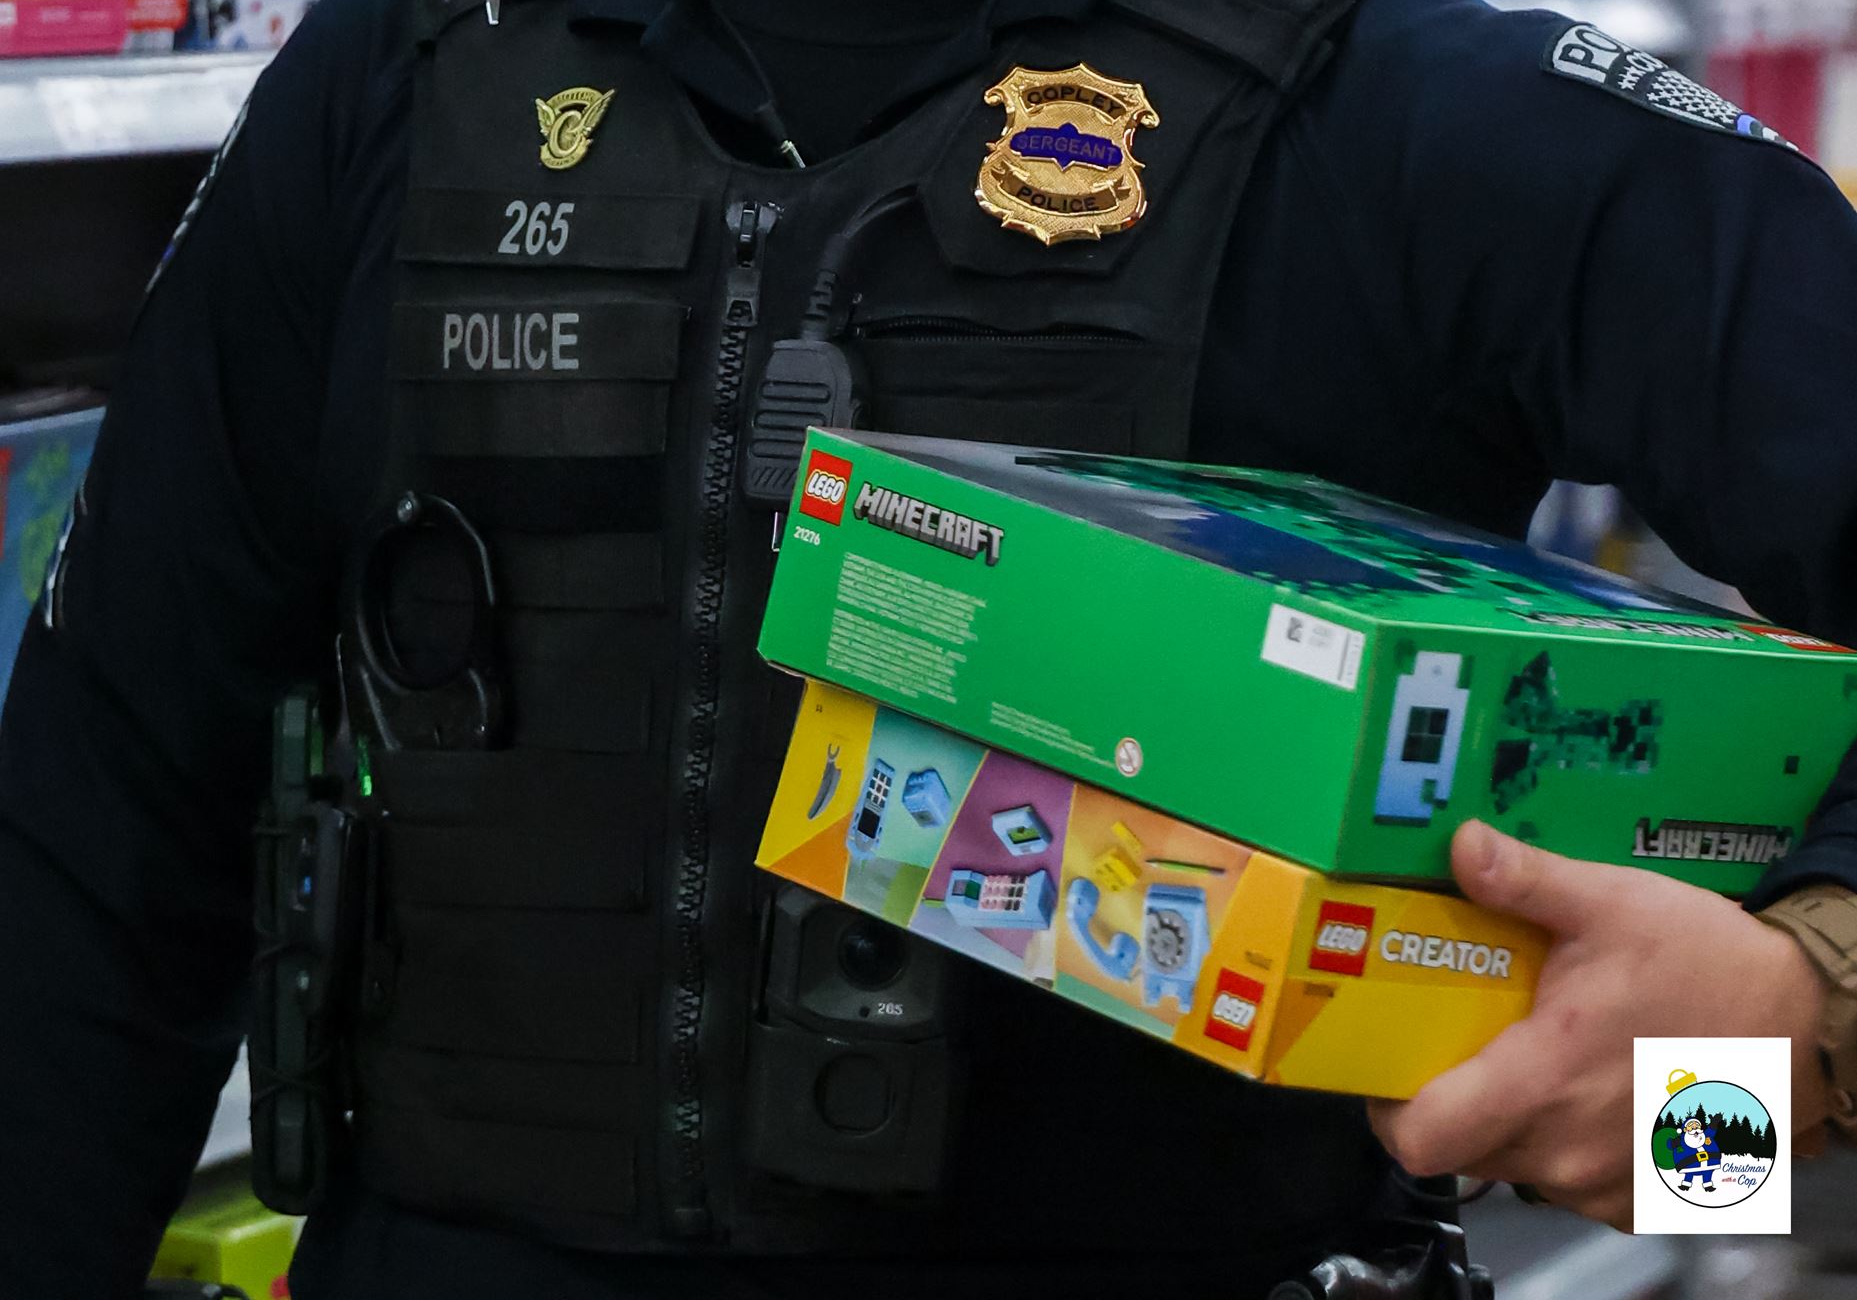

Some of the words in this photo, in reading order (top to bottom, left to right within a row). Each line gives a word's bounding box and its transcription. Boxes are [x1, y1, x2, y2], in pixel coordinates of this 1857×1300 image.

[1026, 85, 1121, 115] COPLEY
[1016, 134, 1116, 163] SERGEANT
[1016, 186, 1099, 212] POLICE
[498, 200, 575, 255] 265
[443, 312, 579, 370] POLICE
[793, 525, 821, 547] 21276
[806, 471, 847, 504] LEGO
[854, 481, 1005, 567] MINECRAFT
[1631, 817, 1794, 864] MINECRAFT
[1315, 922, 1369, 956] LEGO
[1379, 928, 1513, 979] CREATOR
[877, 1002, 903, 1016] 265
[1211, 991, 1257, 1030] LEGO
